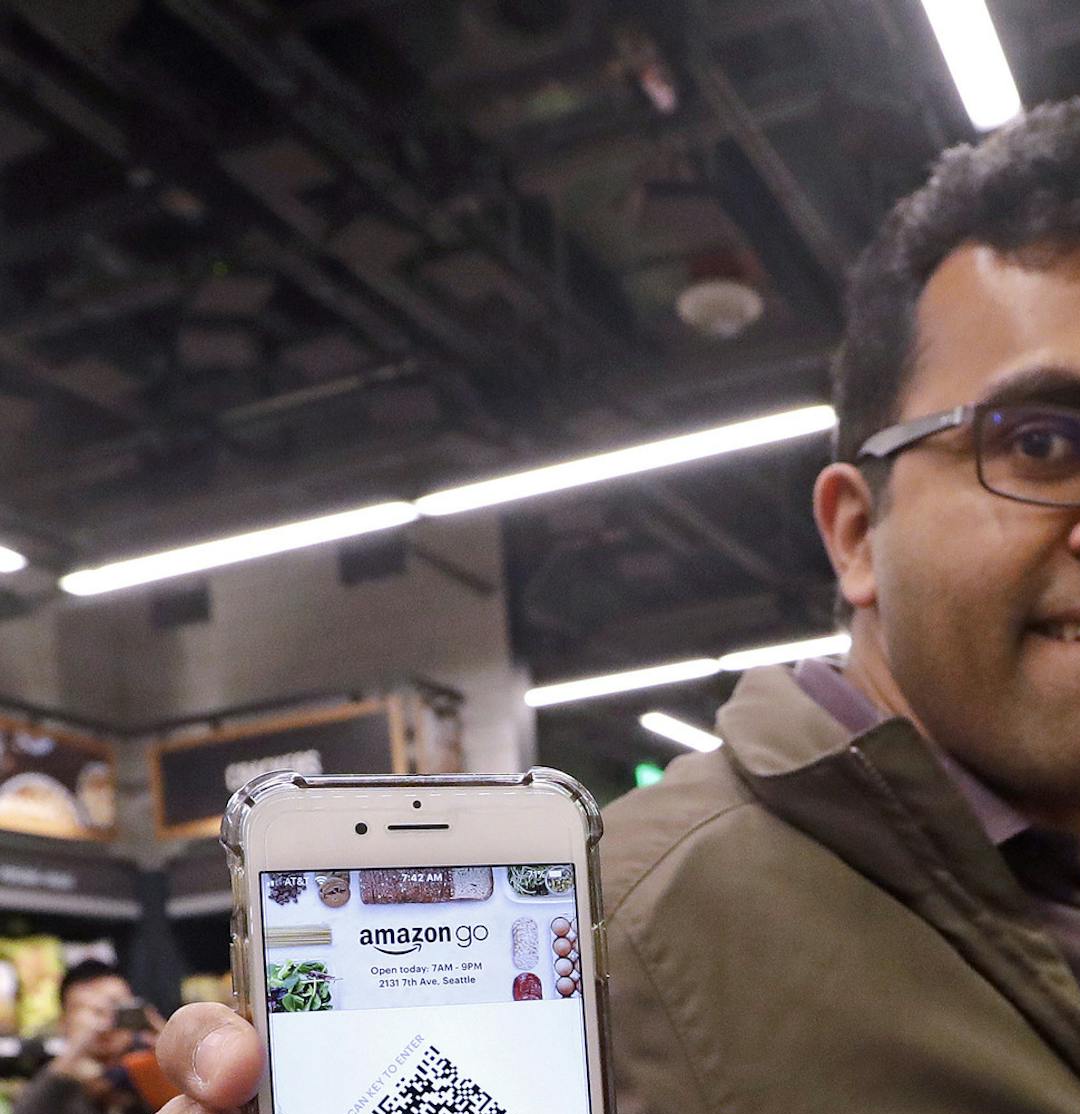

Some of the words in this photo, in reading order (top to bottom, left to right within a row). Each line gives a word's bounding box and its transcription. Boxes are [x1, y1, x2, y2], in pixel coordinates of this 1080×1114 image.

[284, 877, 309, 886] AT&T
[402, 873, 424, 882] 7:42
[426, 873, 443, 881] AM
[360, 926, 451, 945] amazon
[456, 925, 489, 948] go
[370, 966, 397, 975] Open
[400, 964, 429, 974] today:
[432, 964, 453, 972] 7AM
[461, 962, 482, 971] 9PM
[379, 979, 399, 988] 2131
[402, 978, 417, 987] 7th
[442, 975, 476, 985] Seattle
[366, 1077, 384, 1097] KEY
[382, 1064, 397, 1078] TO
[395, 1034, 425, 1065] ENTER
